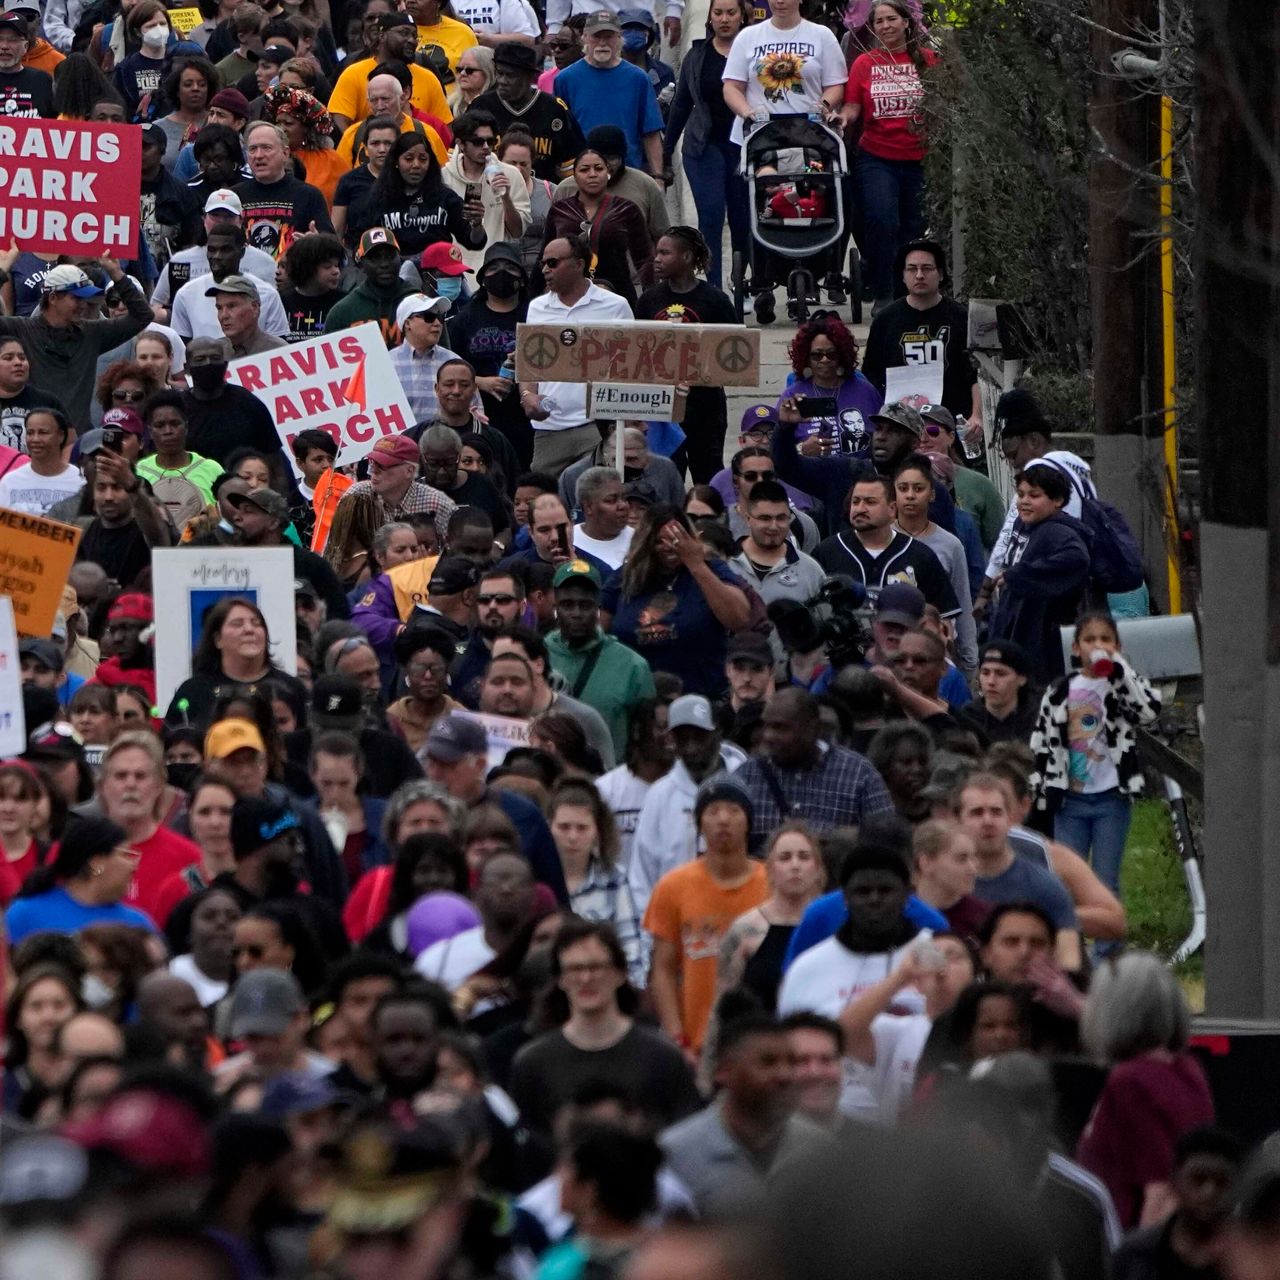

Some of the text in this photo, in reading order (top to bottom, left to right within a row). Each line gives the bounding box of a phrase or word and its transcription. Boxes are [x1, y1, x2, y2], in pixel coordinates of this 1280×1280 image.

[752, 42, 815, 58] INSPIRED
[577, 336, 702, 380] PEACE
[904, 339, 944, 365] 50
[595, 387, 671, 407] #Enough
